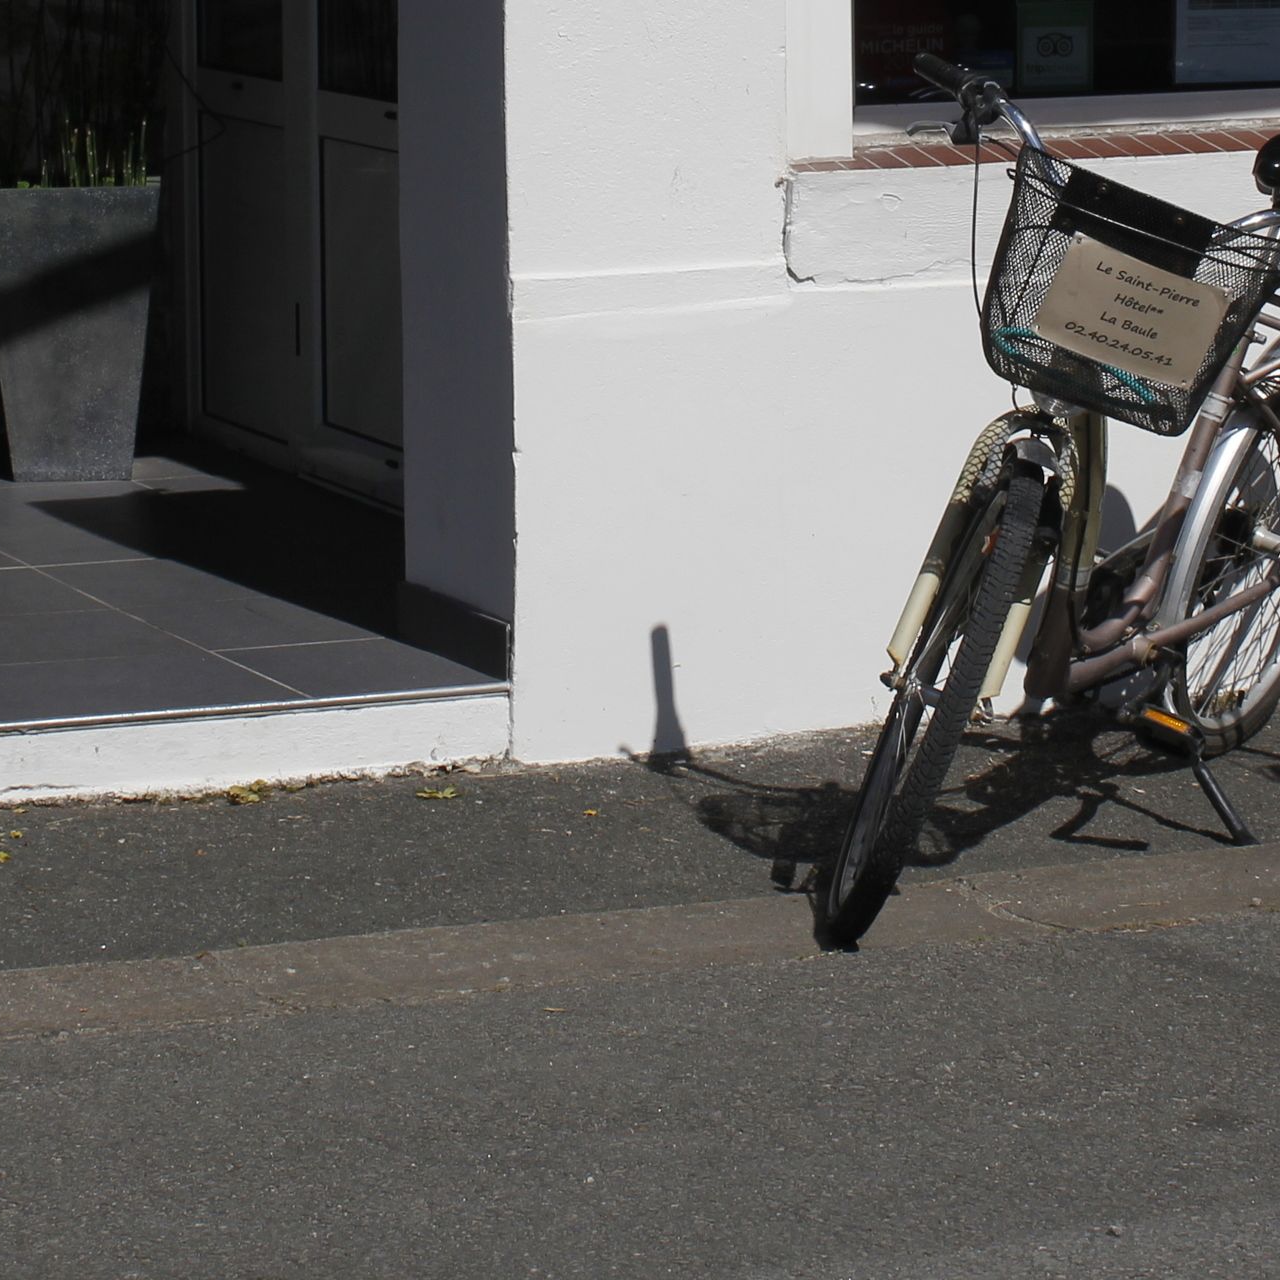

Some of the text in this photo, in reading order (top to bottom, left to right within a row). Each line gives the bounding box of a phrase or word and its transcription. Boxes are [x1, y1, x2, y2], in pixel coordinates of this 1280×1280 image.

[1096, 261, 1201, 307] Le Saint-Pierre
[1100, 311, 1158, 340] La Baule
